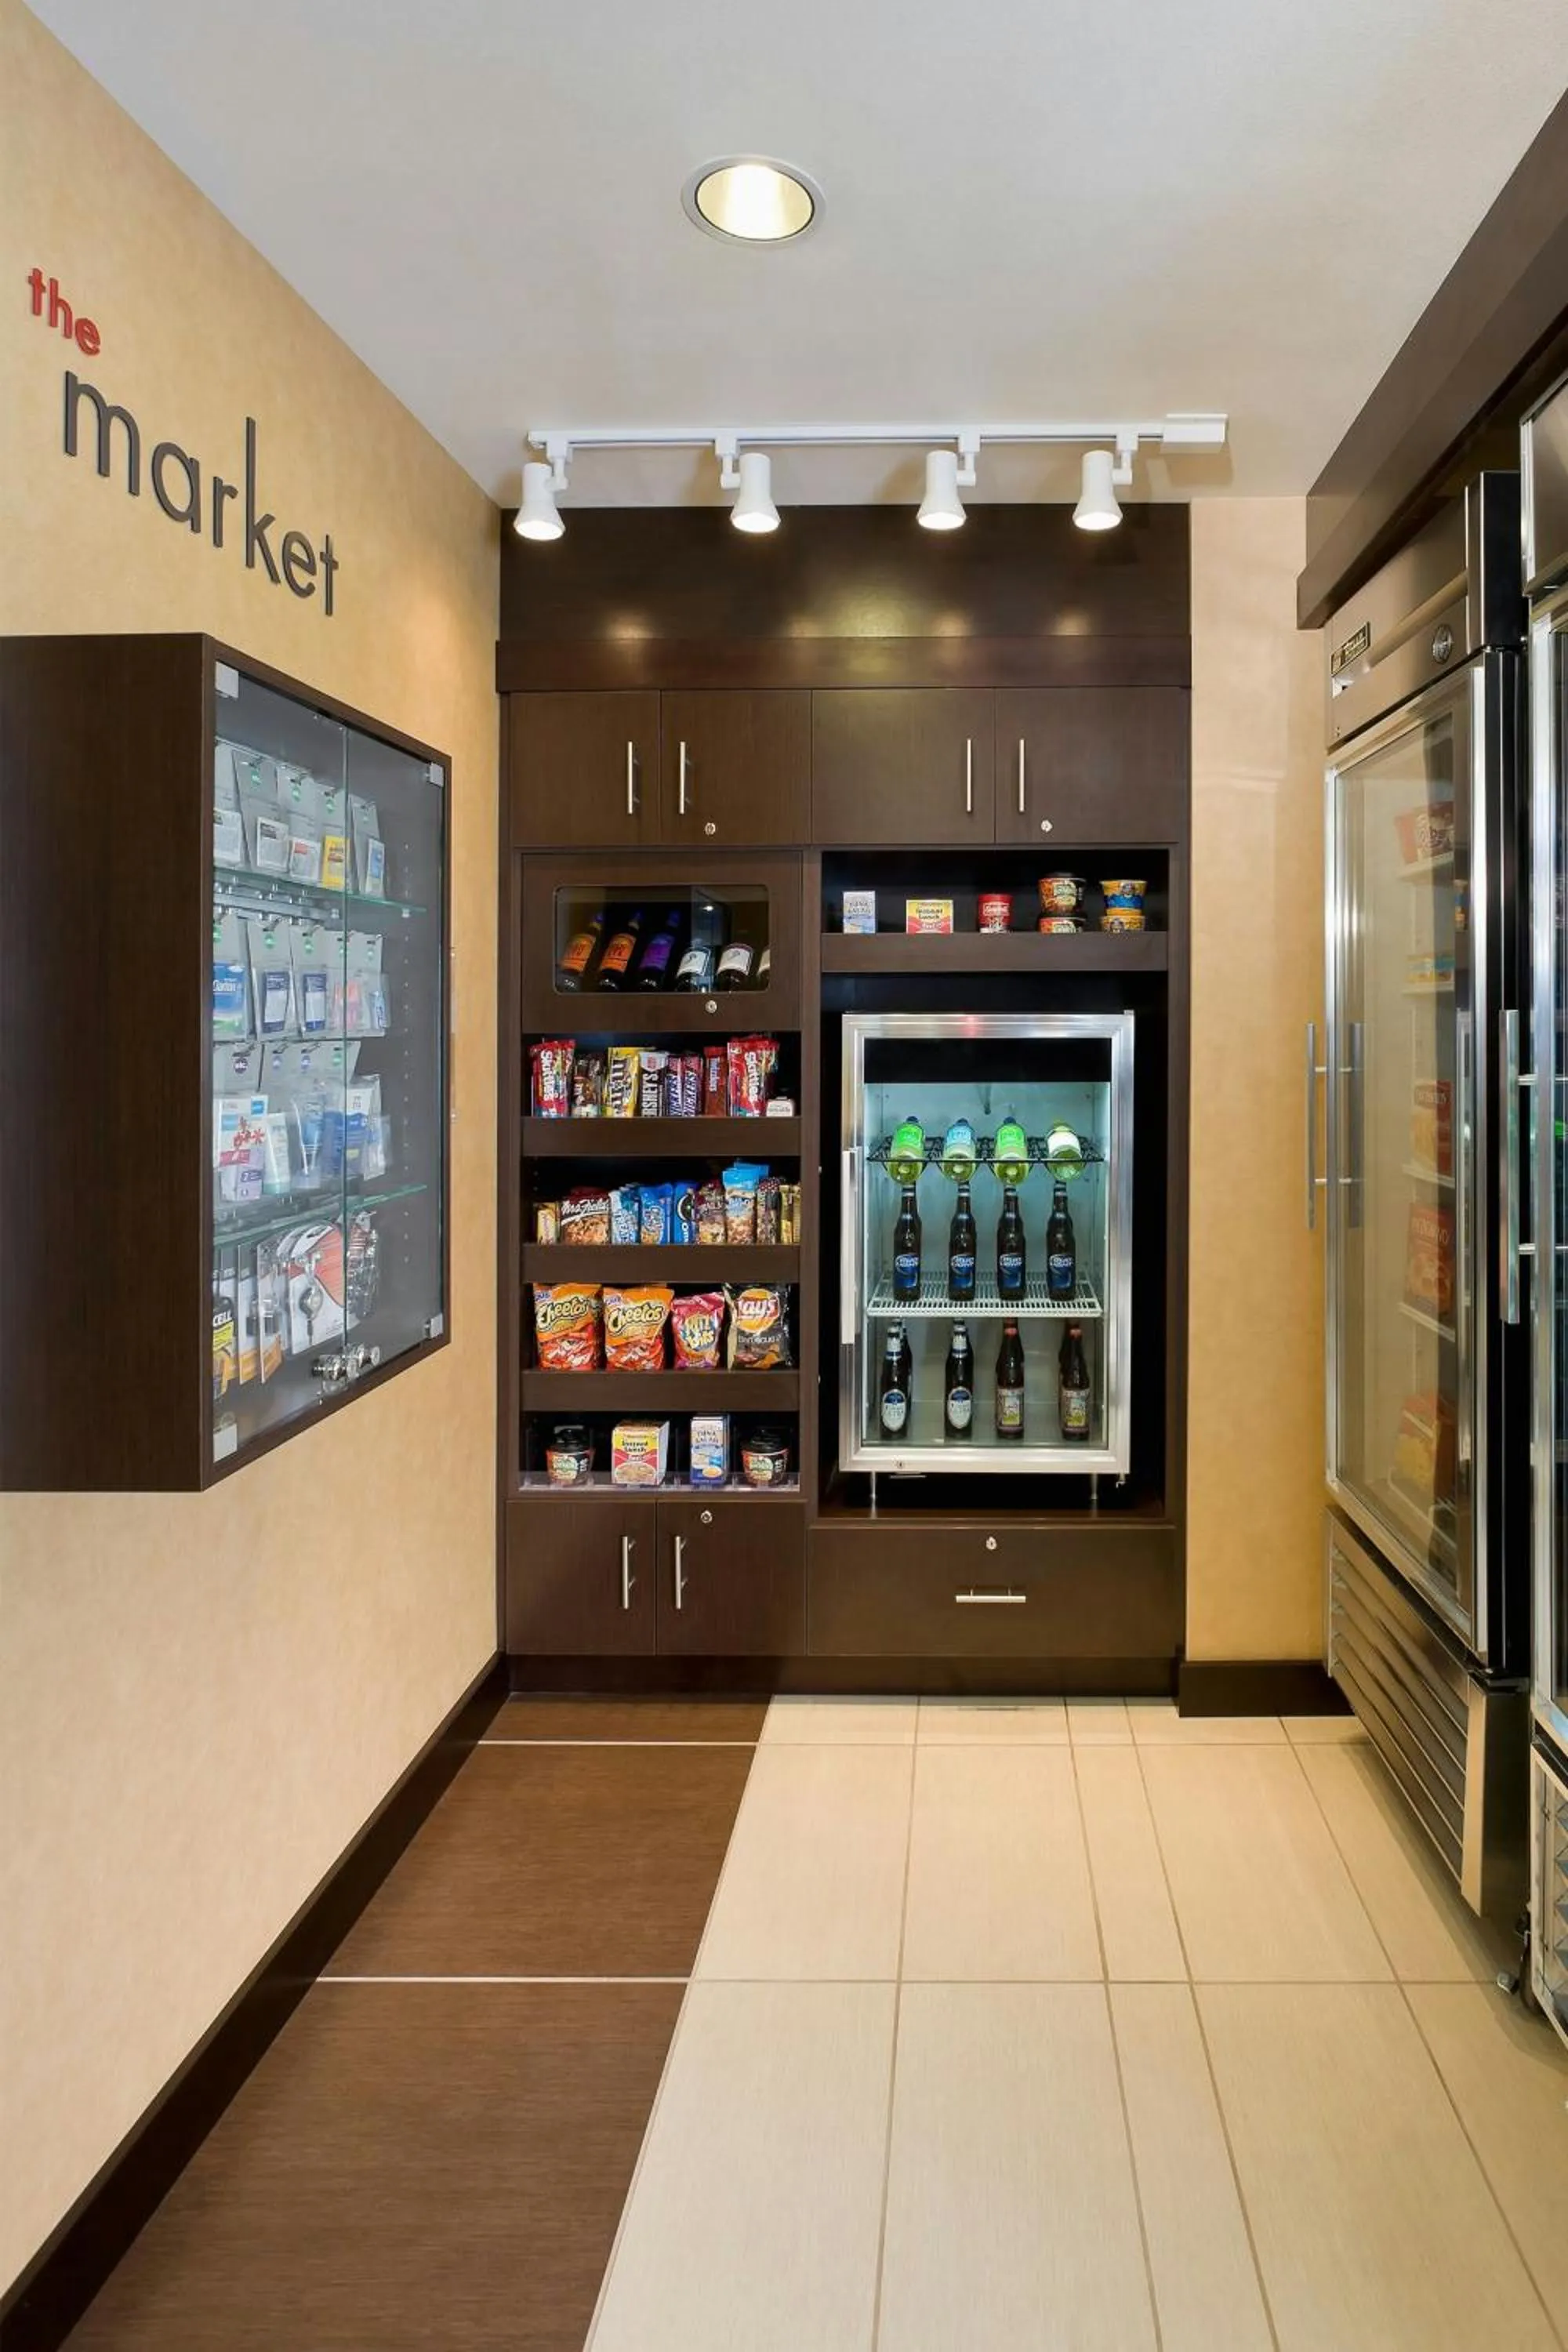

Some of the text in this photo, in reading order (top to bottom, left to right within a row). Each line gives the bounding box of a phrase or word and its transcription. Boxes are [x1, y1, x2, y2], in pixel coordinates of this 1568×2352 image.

[28, 267, 101, 356] the
[64, 370, 339, 616] market
[536, 1297, 591, 1330] Cheetos
[608, 1302, 664, 1334] Cheetos
